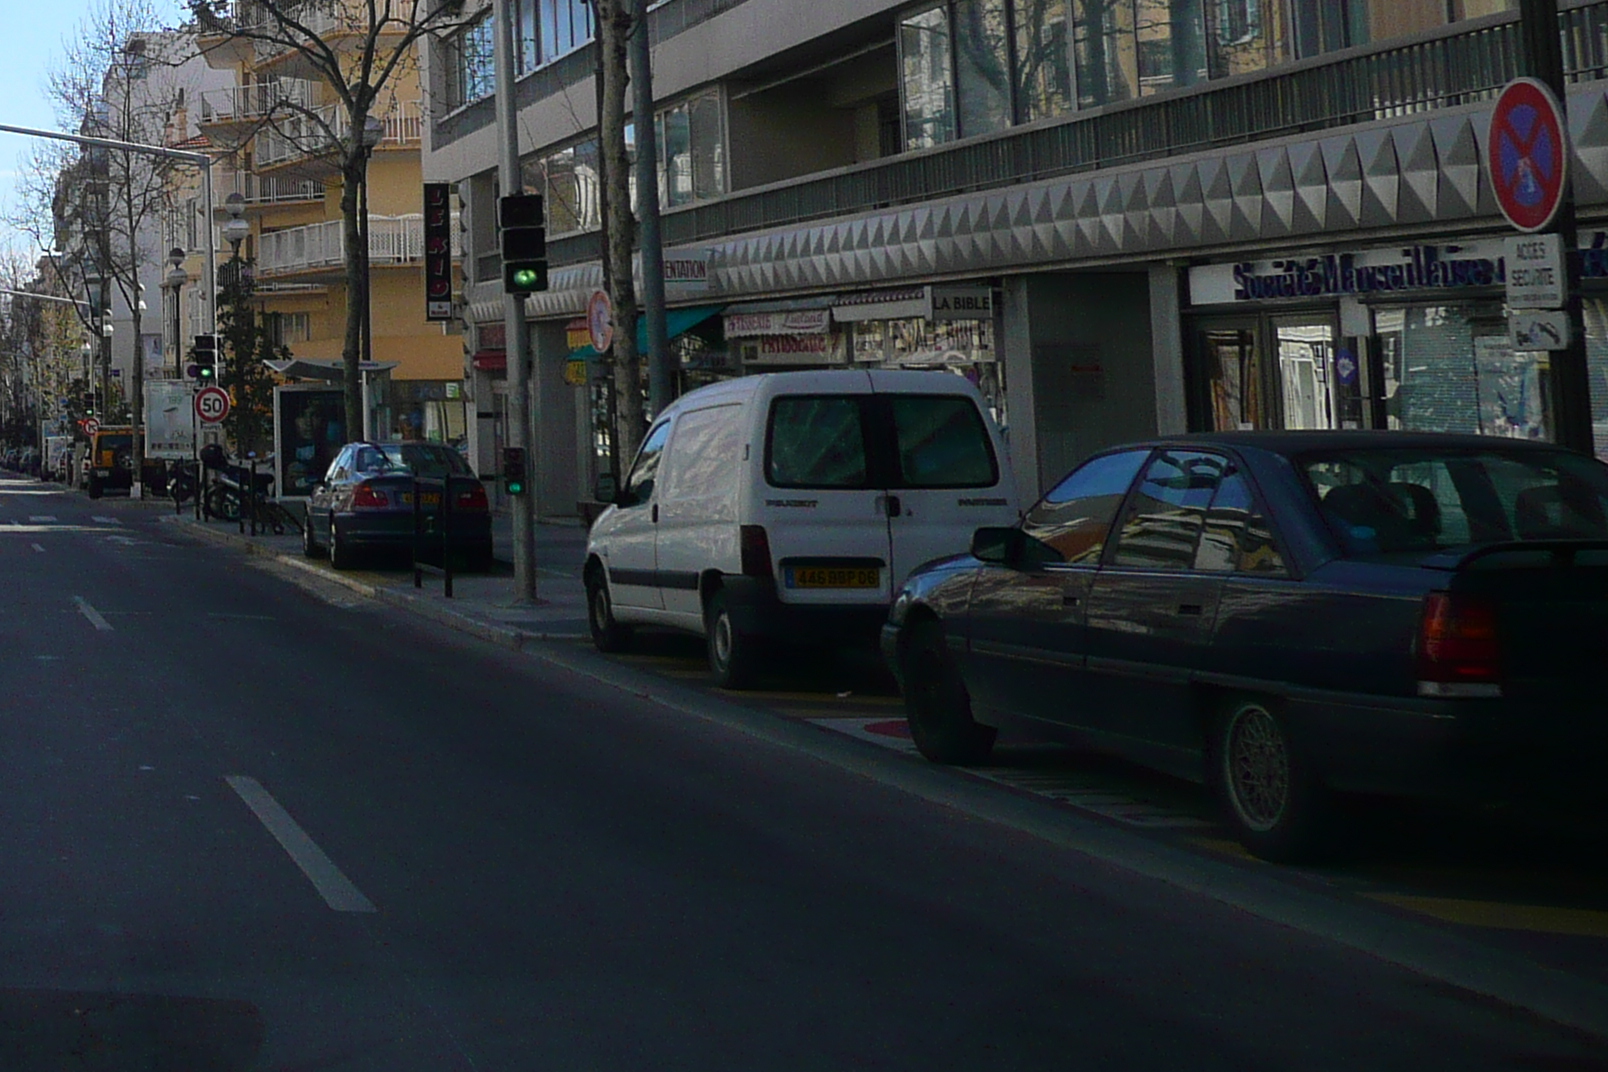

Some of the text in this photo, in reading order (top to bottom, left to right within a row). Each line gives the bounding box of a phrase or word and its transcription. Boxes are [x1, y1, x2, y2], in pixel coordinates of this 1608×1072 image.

[665, 260, 707, 279] ENTATION
[1321, 245, 1493, 295] Marseillaise
[933, 295, 990, 311] LA BIBLE
[202, 398, 222, 413] 50
